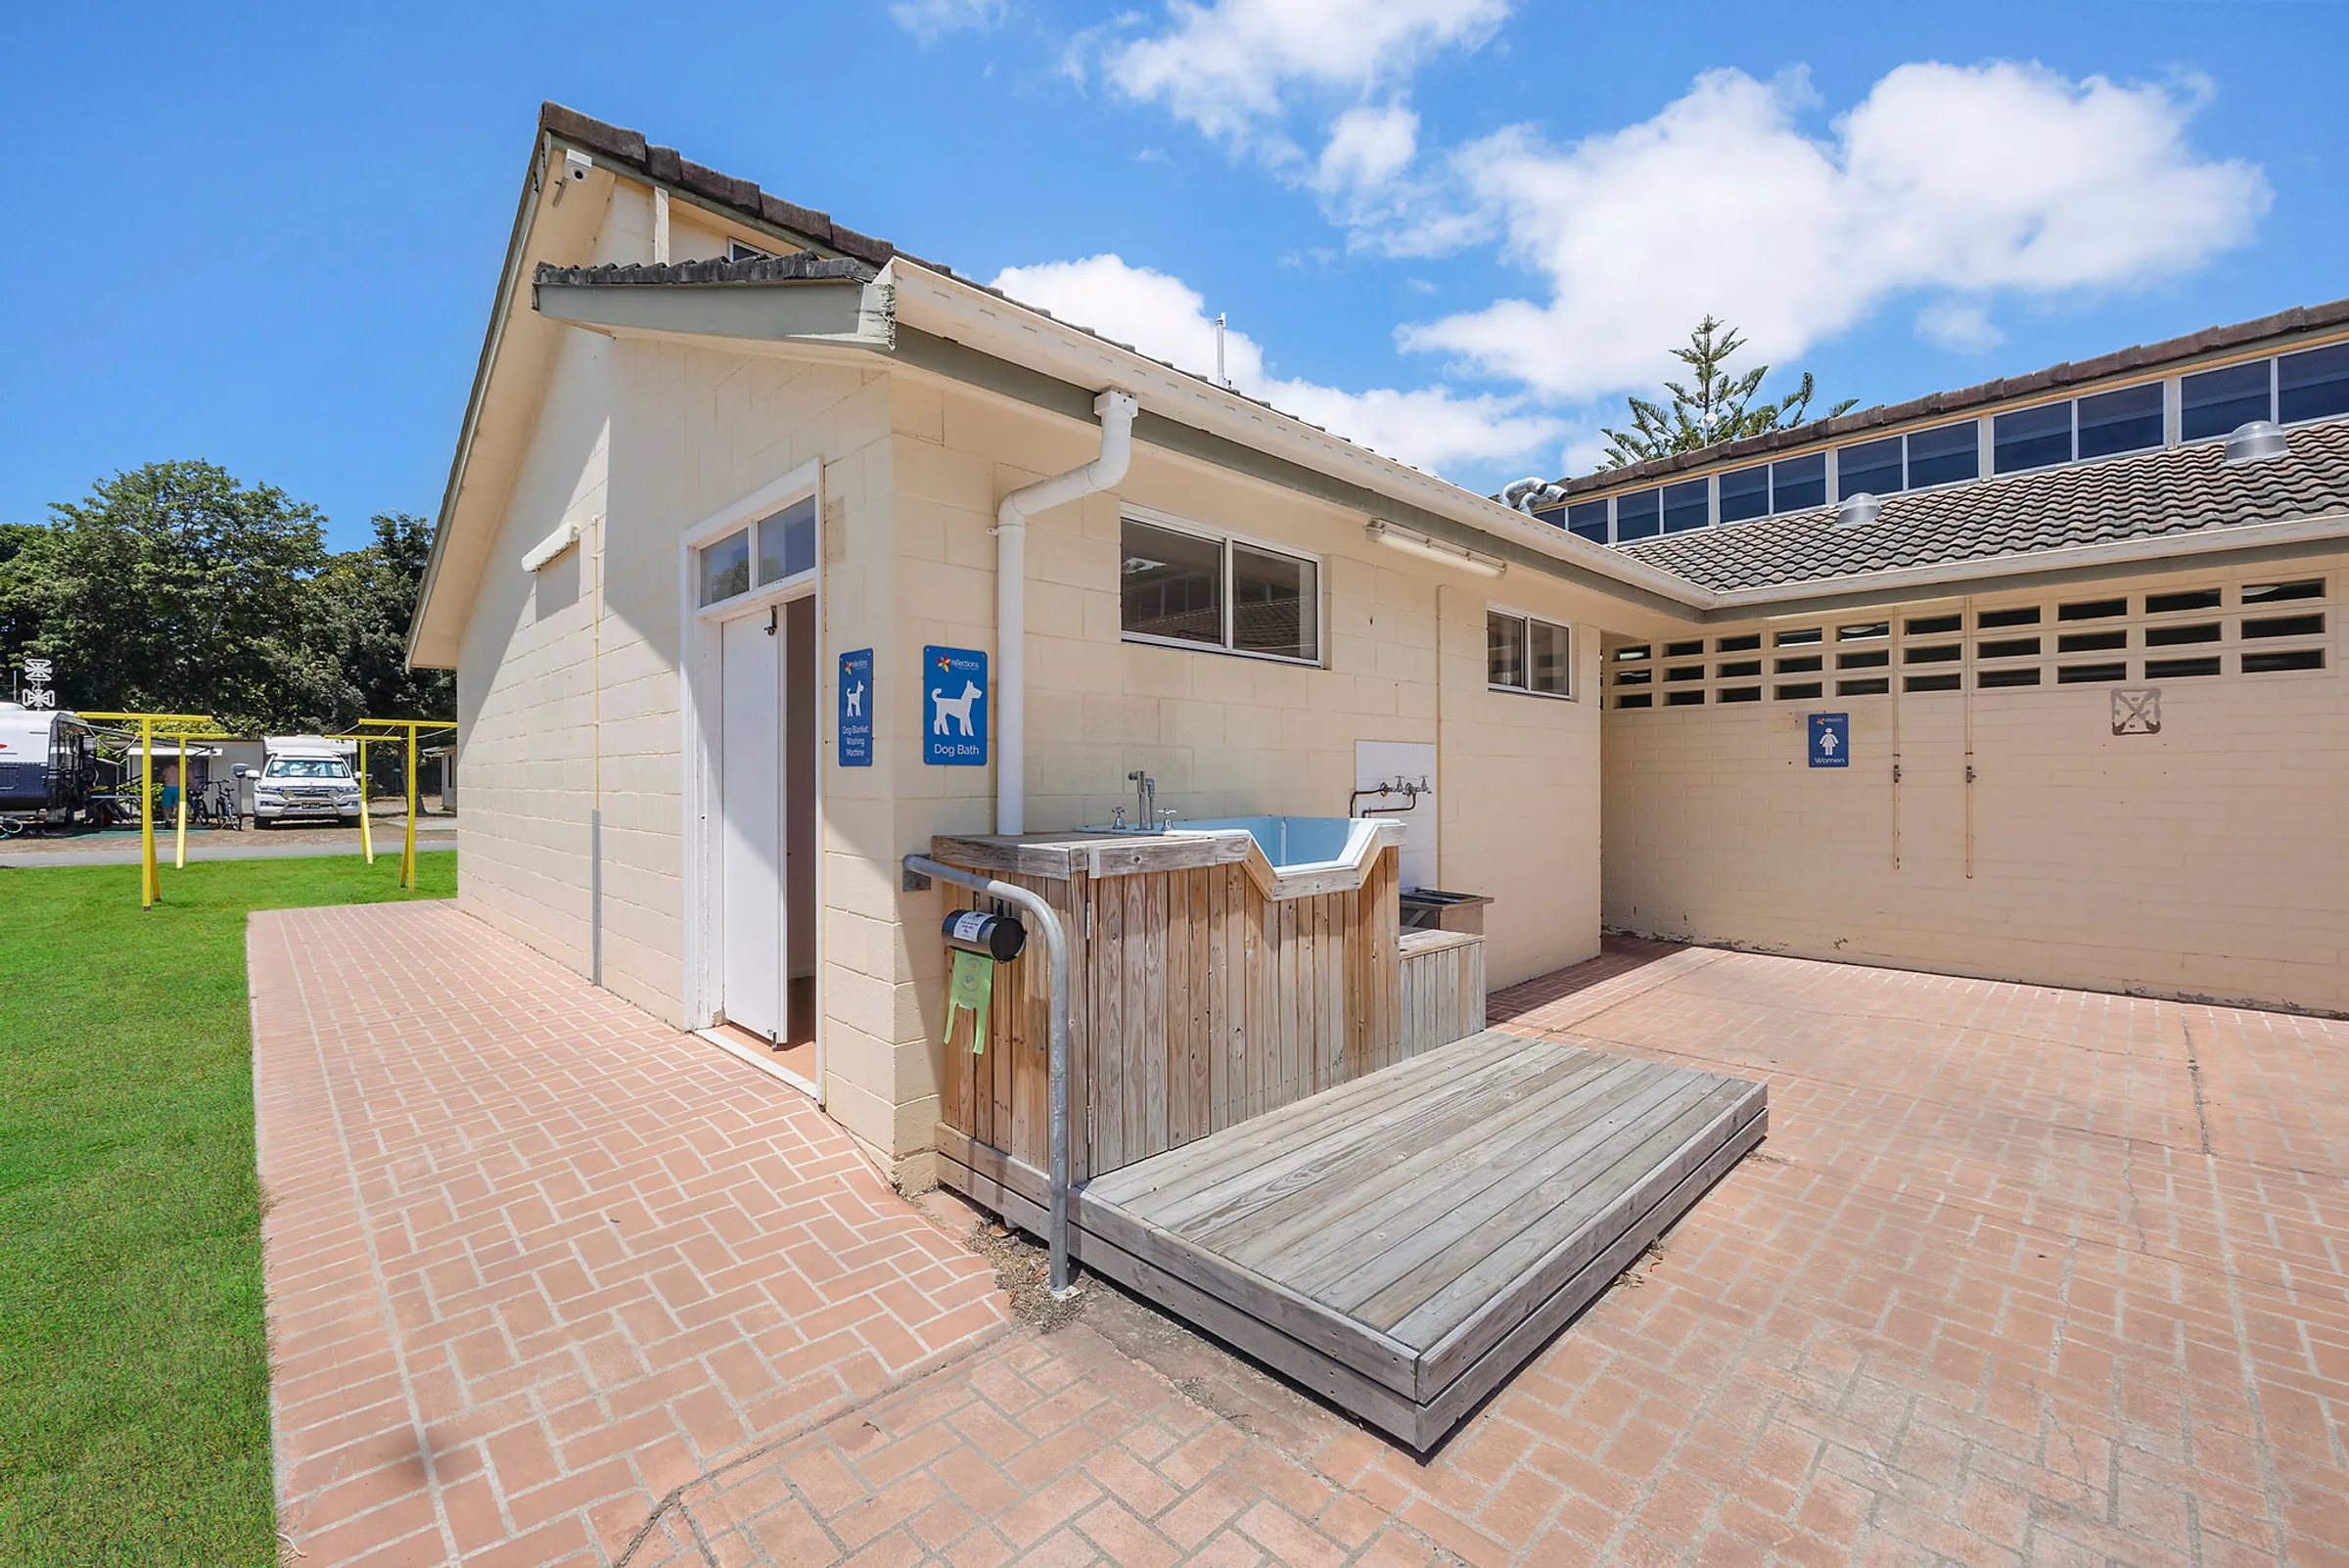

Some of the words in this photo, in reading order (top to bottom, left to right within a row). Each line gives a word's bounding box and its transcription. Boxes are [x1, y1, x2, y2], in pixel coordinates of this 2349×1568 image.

[843, 725, 852, 736] Dog
[846, 736, 864, 746] Washing
[846, 747, 864, 756] Machine
[934, 743, 955, 757] Dog
[957, 744, 979, 755] Bath
